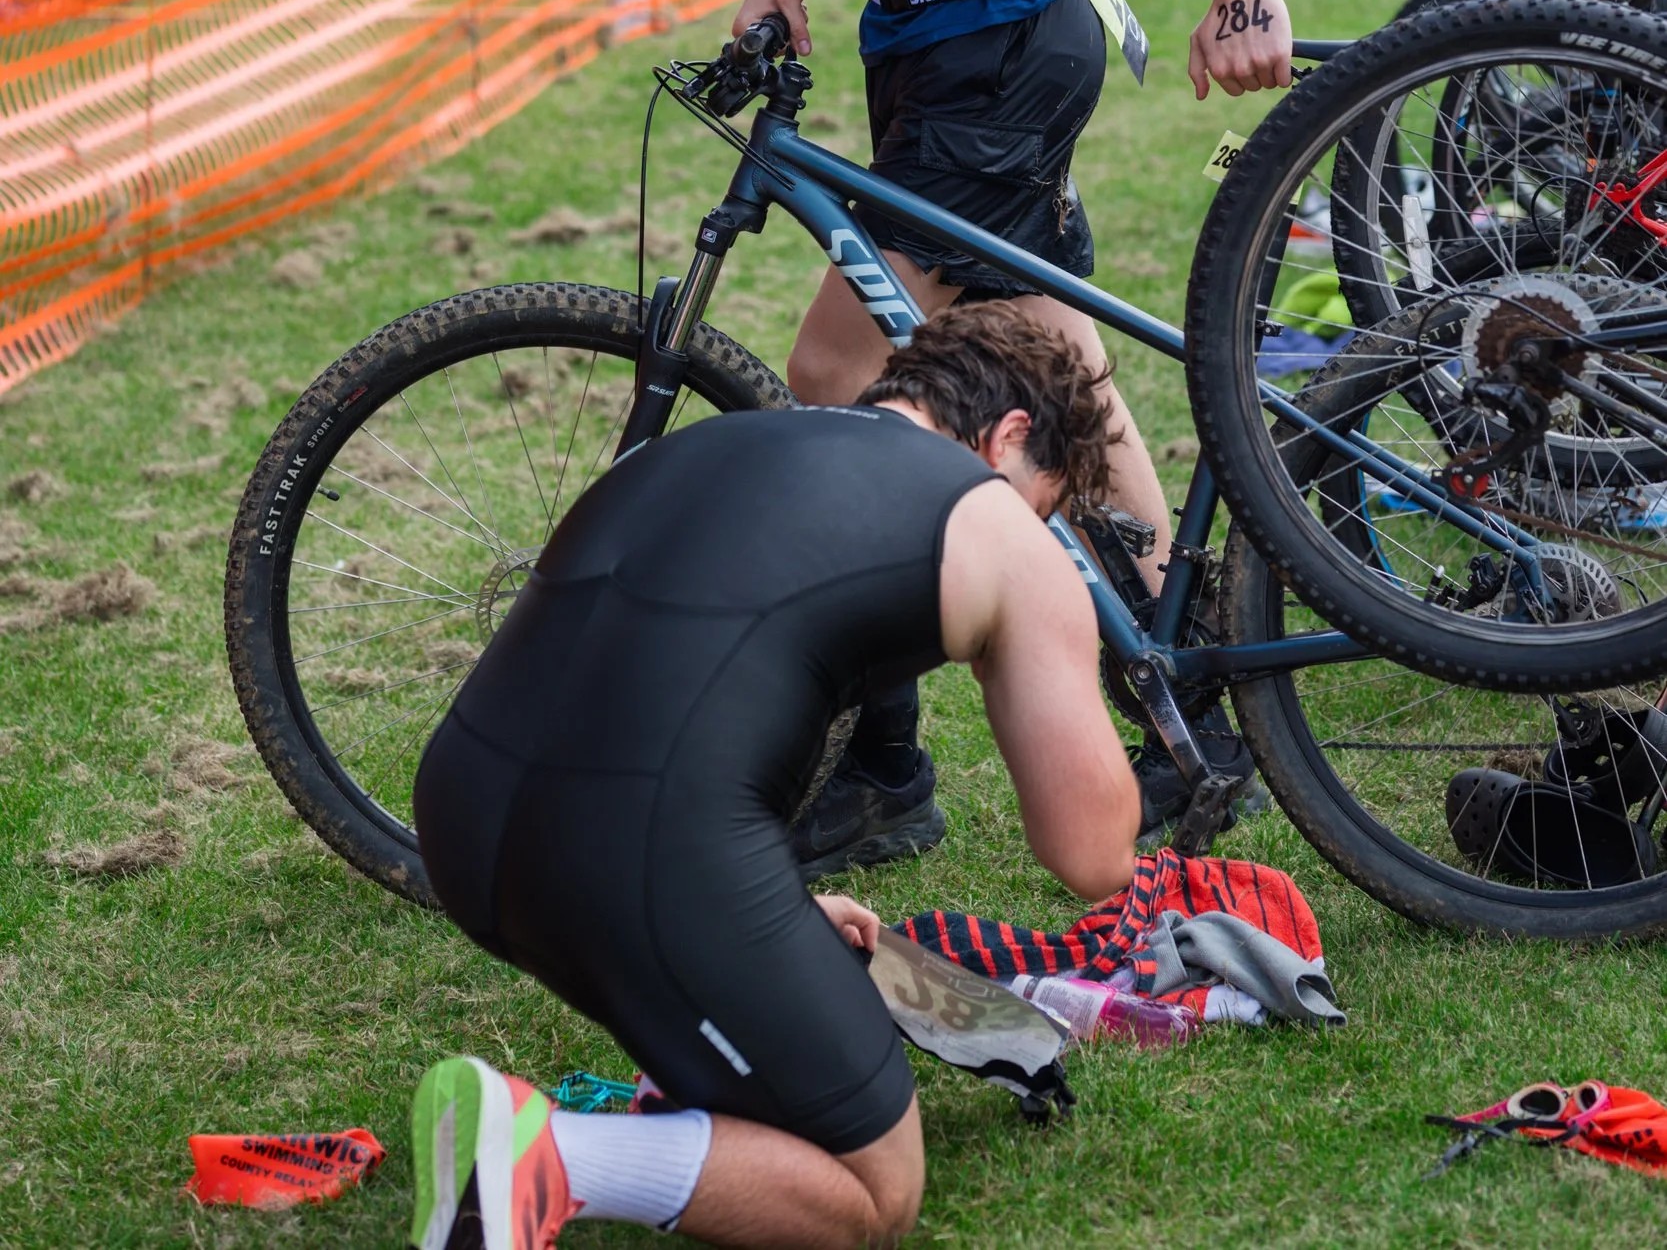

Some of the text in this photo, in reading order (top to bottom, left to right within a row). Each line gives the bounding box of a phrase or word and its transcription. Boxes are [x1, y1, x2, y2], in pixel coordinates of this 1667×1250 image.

[1560, 32, 1667, 70] VEE TIRE
[1212, 145, 1240, 169] 28
[259, 416, 335, 555] FAST TRAK SPORT
[220, 1154, 315, 1188] COUNTY RELAY
[241, 1138, 334, 1174] SWIMMING
